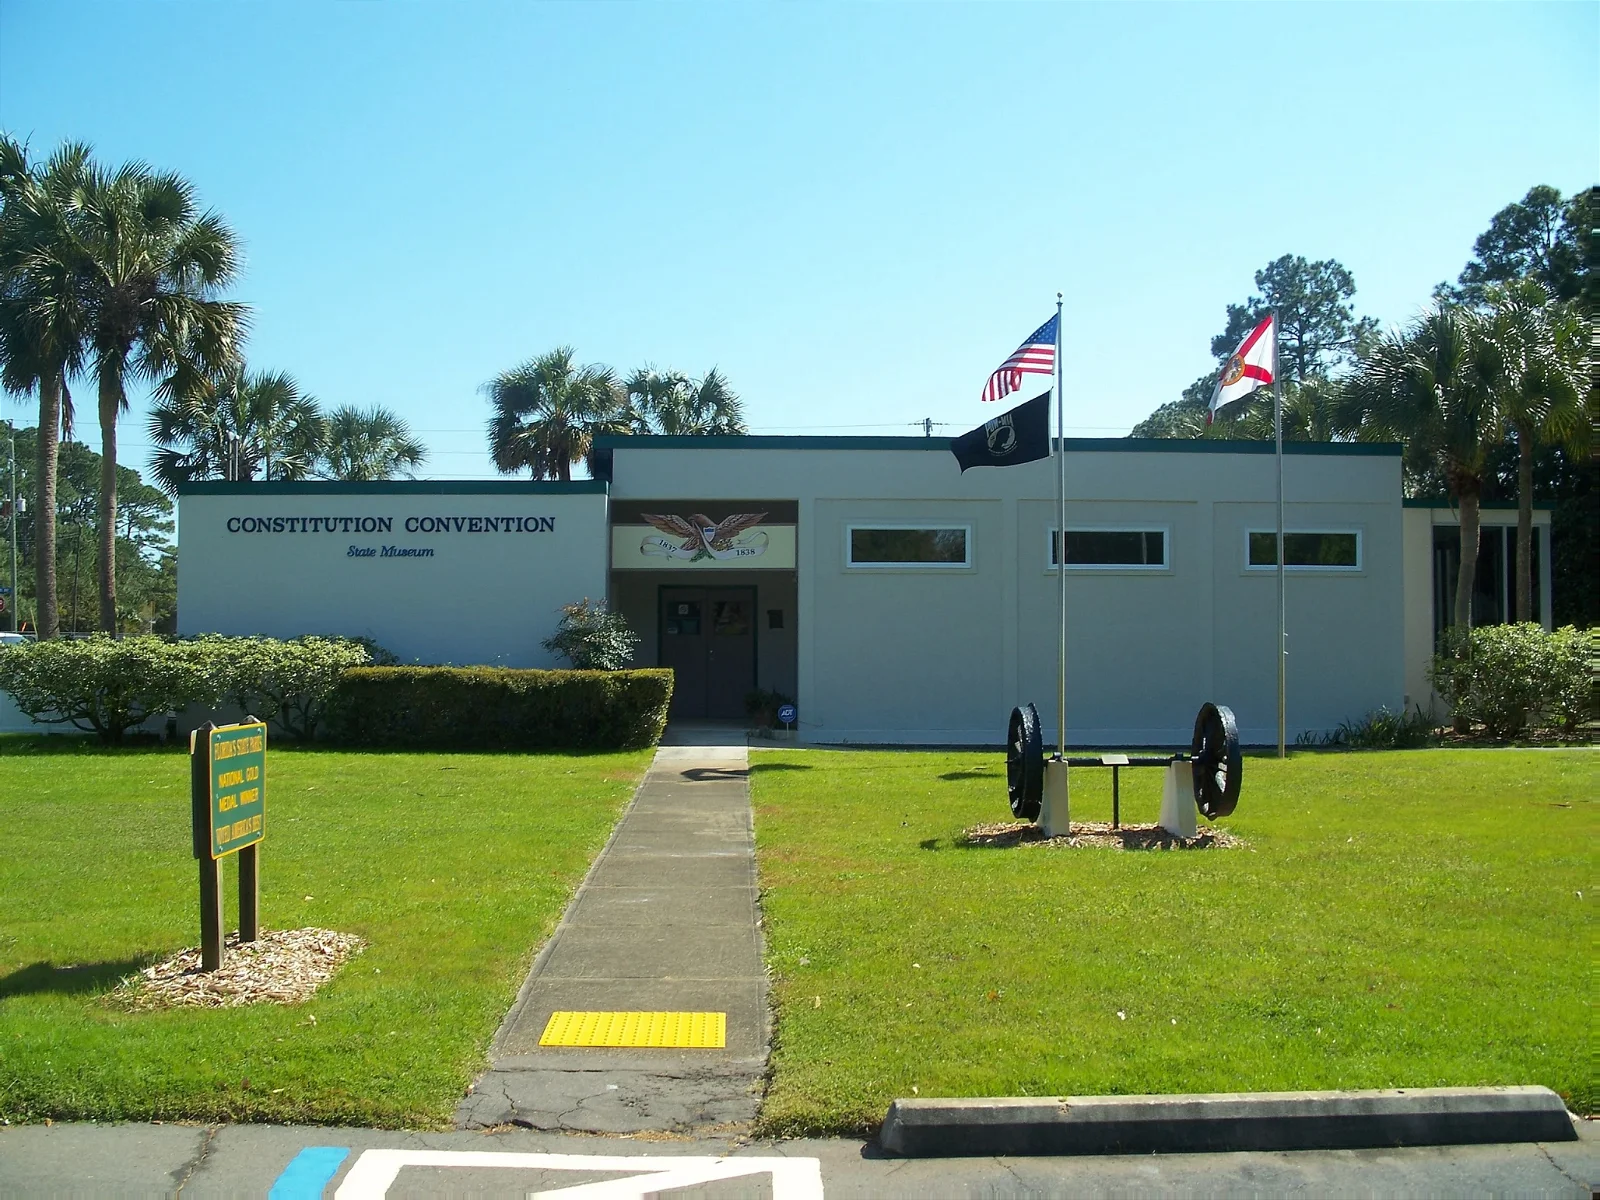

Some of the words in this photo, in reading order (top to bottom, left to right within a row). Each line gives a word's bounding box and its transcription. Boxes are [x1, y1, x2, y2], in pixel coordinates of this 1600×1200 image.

[226, 517, 393, 533] CONSTITUTION
[404, 517, 556, 533] CONVENTION
[346, 545, 377, 557] State
[379, 545, 435, 557] Museum
[658, 539, 678, 553] 1837
[781, 709, 793, 717] ADT
[219, 770, 244, 788] NATIONAL
[246, 766, 259, 781] GOLD
[219, 794, 238, 812] MEDAL
[240, 788, 259, 805] WINNER
